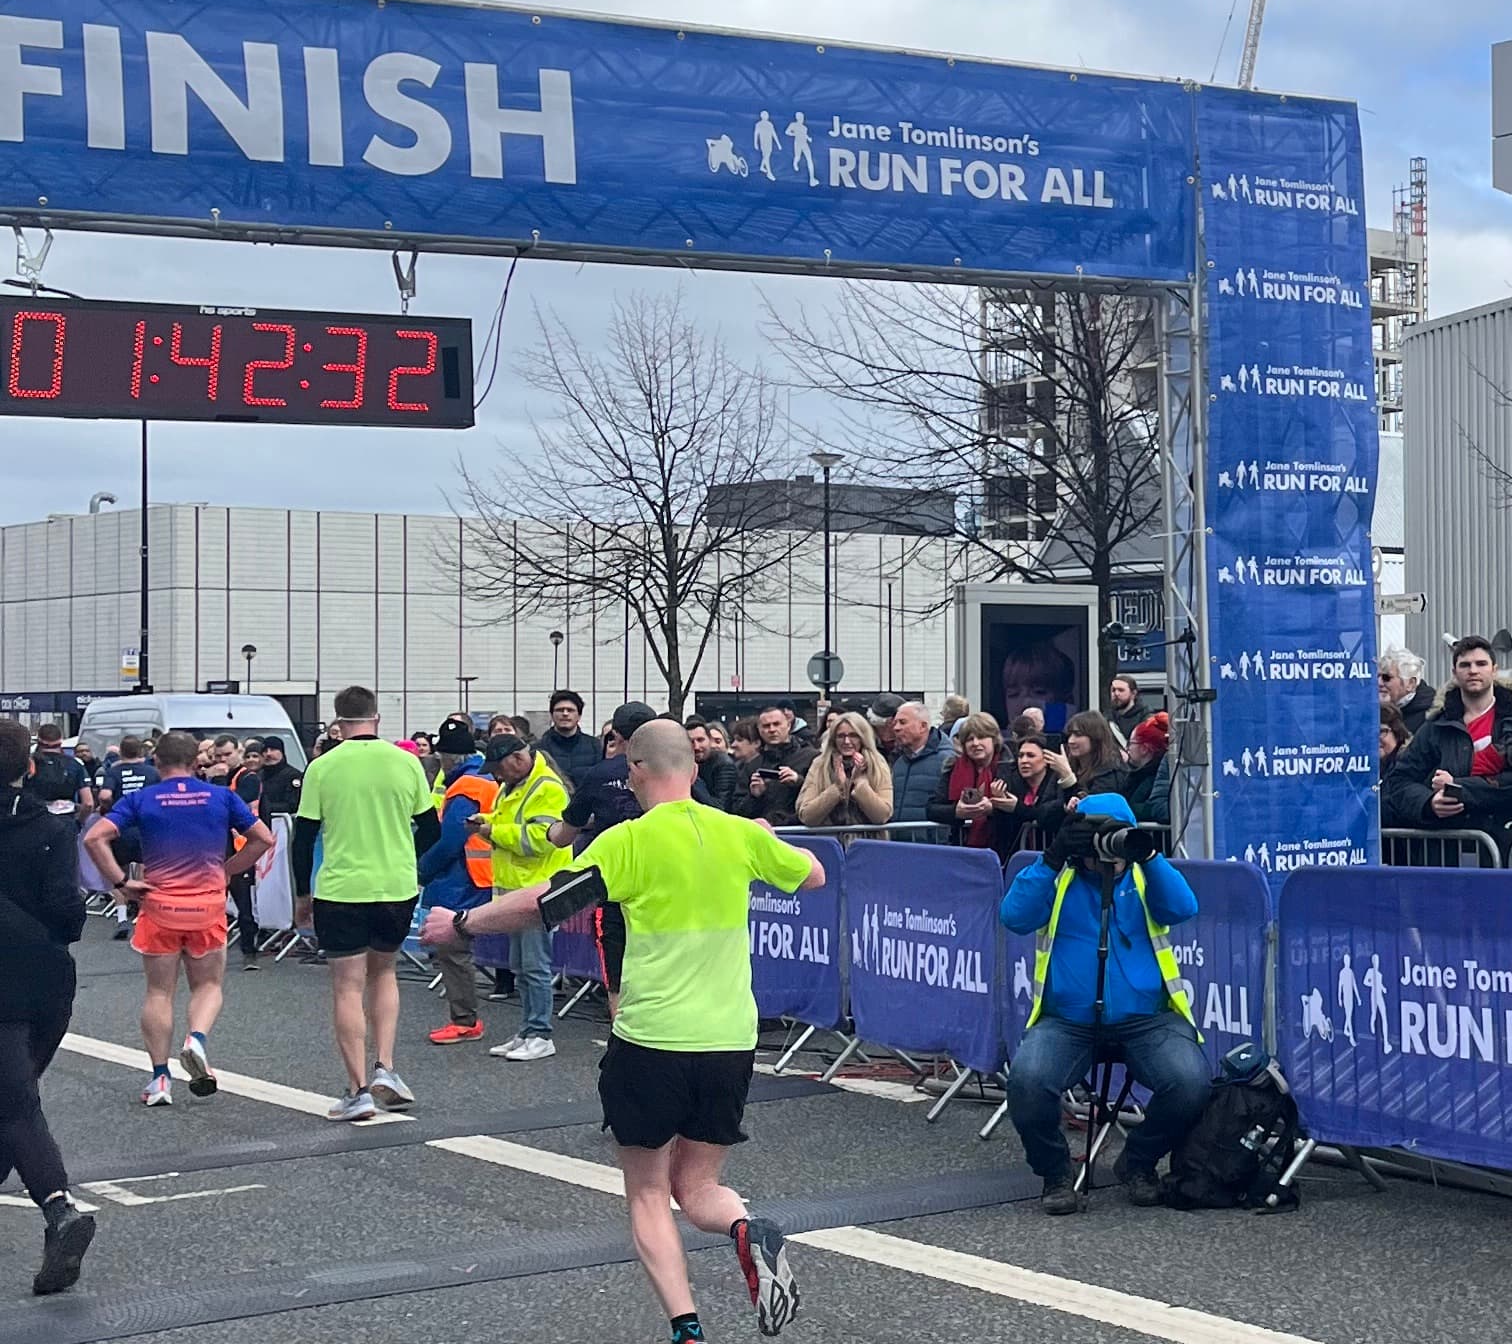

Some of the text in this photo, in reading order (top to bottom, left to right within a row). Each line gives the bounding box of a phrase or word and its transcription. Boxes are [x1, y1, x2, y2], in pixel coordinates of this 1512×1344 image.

[0, 15, 577, 185] FINISH
[827, 115, 1040, 157] Jane Tomlinson's
[827, 148, 1114, 209] RUN FOR ALL
[1255, 190, 1358, 215] RUN FOR ALL
[1263, 285, 1363, 308] RUN FOR ALL
[1266, 365, 1290, 375] Jane
[1266, 377, 1367, 401] RUN FOR ALL
[1265, 461, 1290, 471] Jane
[1264, 474, 1368, 494] RUN FOR ALL
[1265, 556, 1292, 566] Jane
[1264, 568, 1366, 585] RUN FOR ALL
[1270, 650, 1350, 660] Jane Tomlinson's
[1270, 662, 1371, 680] RUN FOR ALL
[1273, 746, 1298, 756] Jane
[1273, 755, 1370, 775] RUN FOR ALL
[1275, 848, 1366, 872] RUN FOR ALL
[883, 904, 957, 937] Jane Tomlinson's
[758, 921, 794, 960] FOR
[800, 926, 830, 965] ALL
[882, 937, 988, 994] RUN FOR ALL
[1400, 956, 1457, 989] Jane
[1203, 982, 1252, 1037] ALL
[1400, 1000, 1495, 1063] RUN
